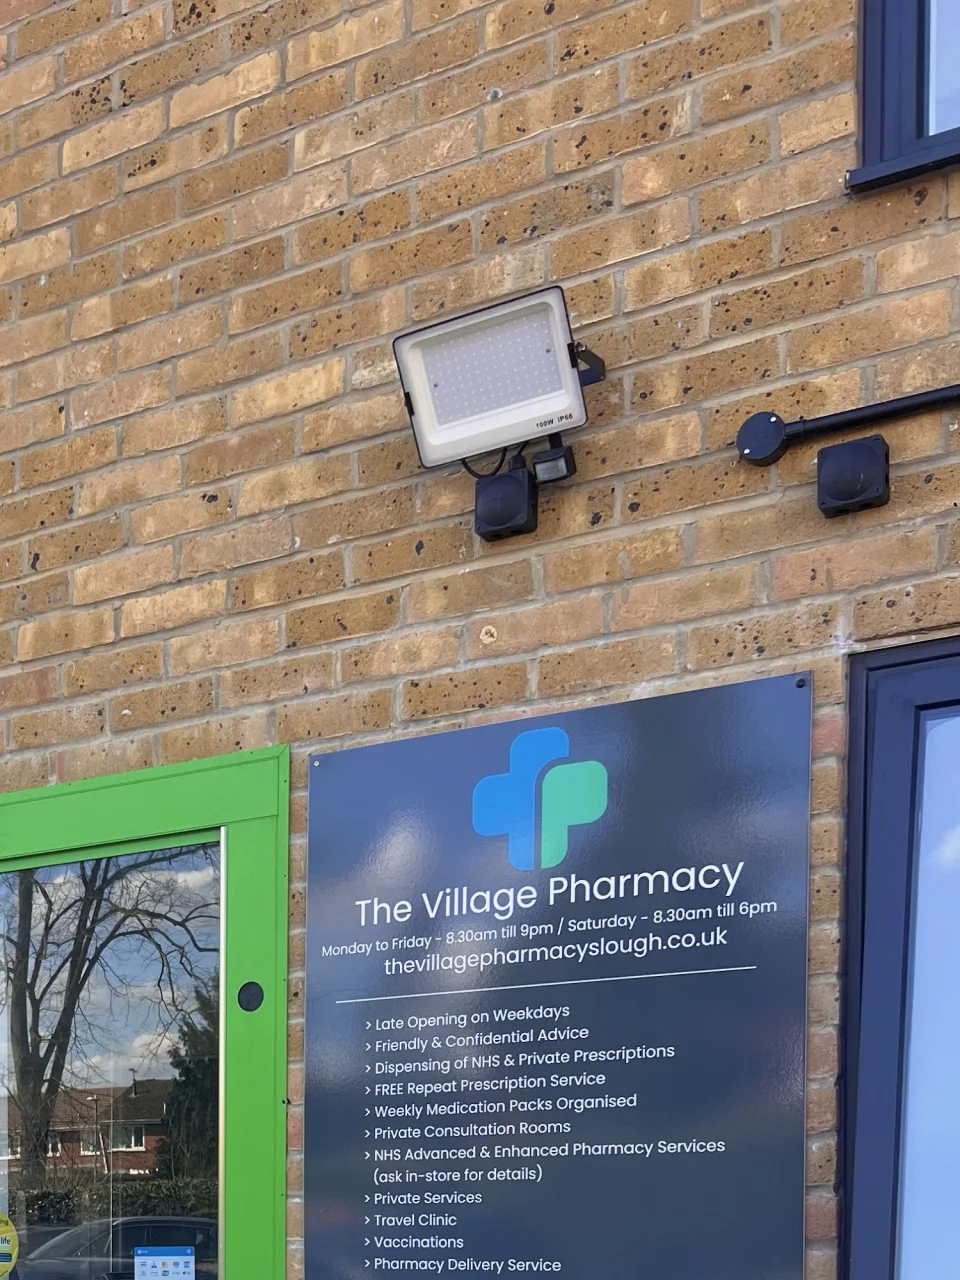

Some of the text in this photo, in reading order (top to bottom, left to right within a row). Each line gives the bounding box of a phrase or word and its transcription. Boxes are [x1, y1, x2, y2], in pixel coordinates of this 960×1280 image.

[355, 860, 745, 927] The Village Pharmacy
[321, 942, 373, 957] Monday
[376, 940, 389, 951] to
[392, 935, 432, 950] Friday
[446, 929, 497, 944] 8.30am
[501, 925, 517, 939] till
[520, 923, 553, 940] 9pm
[557, 916, 565, 936] /
[568, 914, 637, 933] Saturday
[653, 907, 712, 924] 8.30am
[716, 902, 734, 917] till
[739, 901, 777, 919] 6pm
[384, 926, 728, 975] thevillagepharmacyslough.co.uk
[376, 1006, 570, 1031] Late Opening on Weekdays
[376, 1026, 589, 1053] Friendly & Confidential Advice
[375, 1045, 675, 1076] Dispensing of NHS & Private Prescriptions
[375, 1072, 606, 1097] FREE Repeat Prescription Service
[375, 1093, 637, 1119] Weekly Medication Packs Organised
[374, 1121, 571, 1139] Private Consultation Rooms
[374, 1138, 725, 1161] NHS Advanced & Enhanced Pharmacy Services
[373, 1163, 543, 1186] (ask in-store for details)
[374, 1191, 482, 1204] Private Services
[374, 1213, 457, 1226] Travel Clinic
[374, 1235, 464, 1249] Vaccinations
[374, 1258, 562, 1274] Pharmacy Delivery Service
